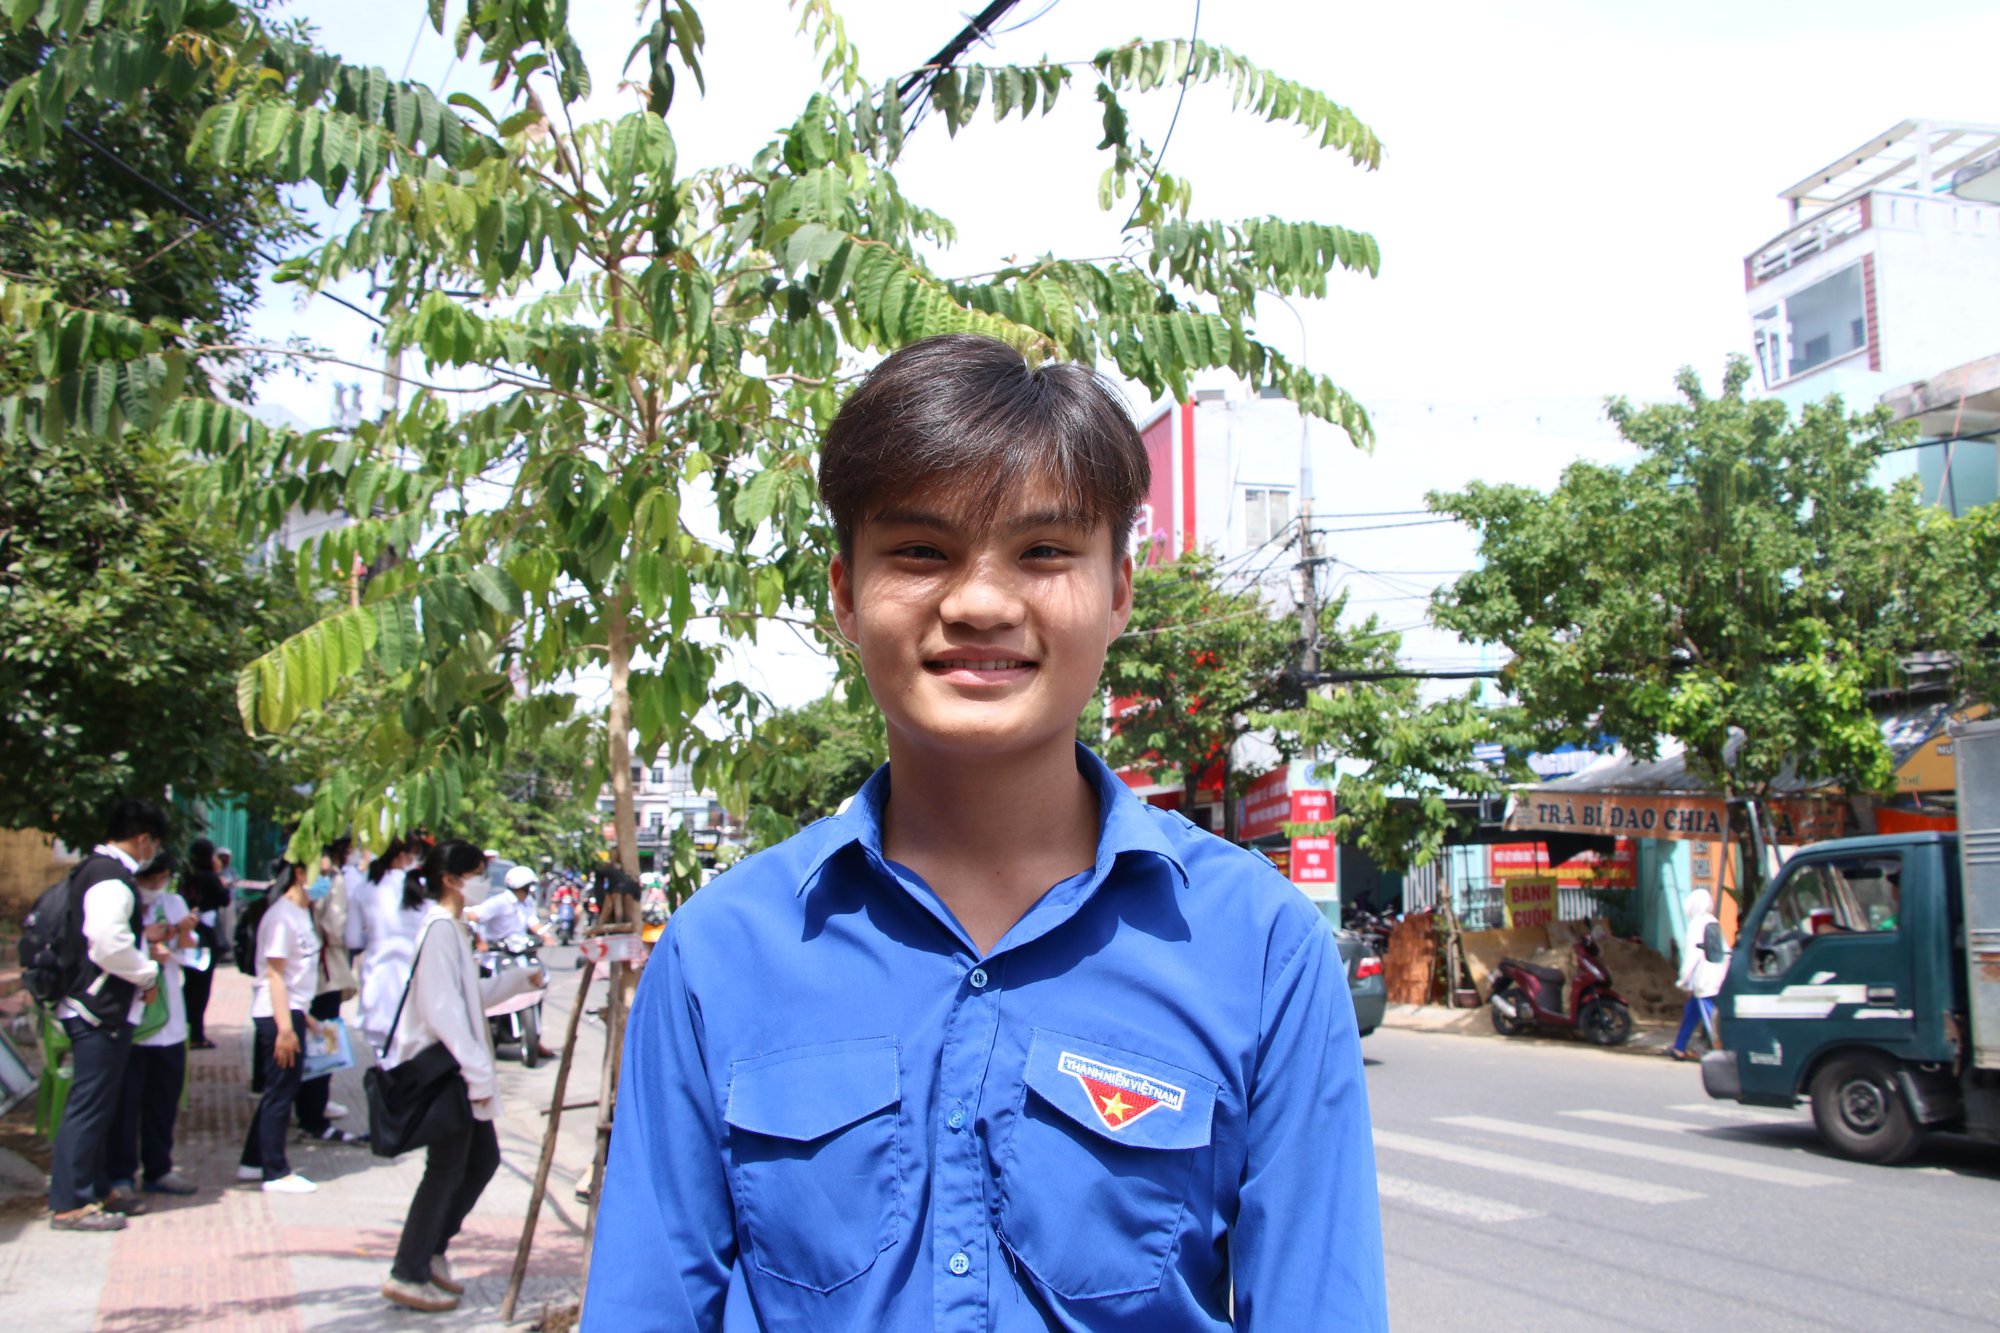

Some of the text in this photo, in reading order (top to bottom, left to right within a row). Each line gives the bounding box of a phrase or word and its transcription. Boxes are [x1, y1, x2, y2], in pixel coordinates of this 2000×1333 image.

[1537, 799, 1576, 825] TRÀ
[1610, 806, 1655, 829] ĐAO
[1663, 808, 1721, 833] CHIA
[1511, 881, 1551, 903] BÁNH
[1066, 1060, 1179, 1105] THANH NIÊN VIỆT NAM
